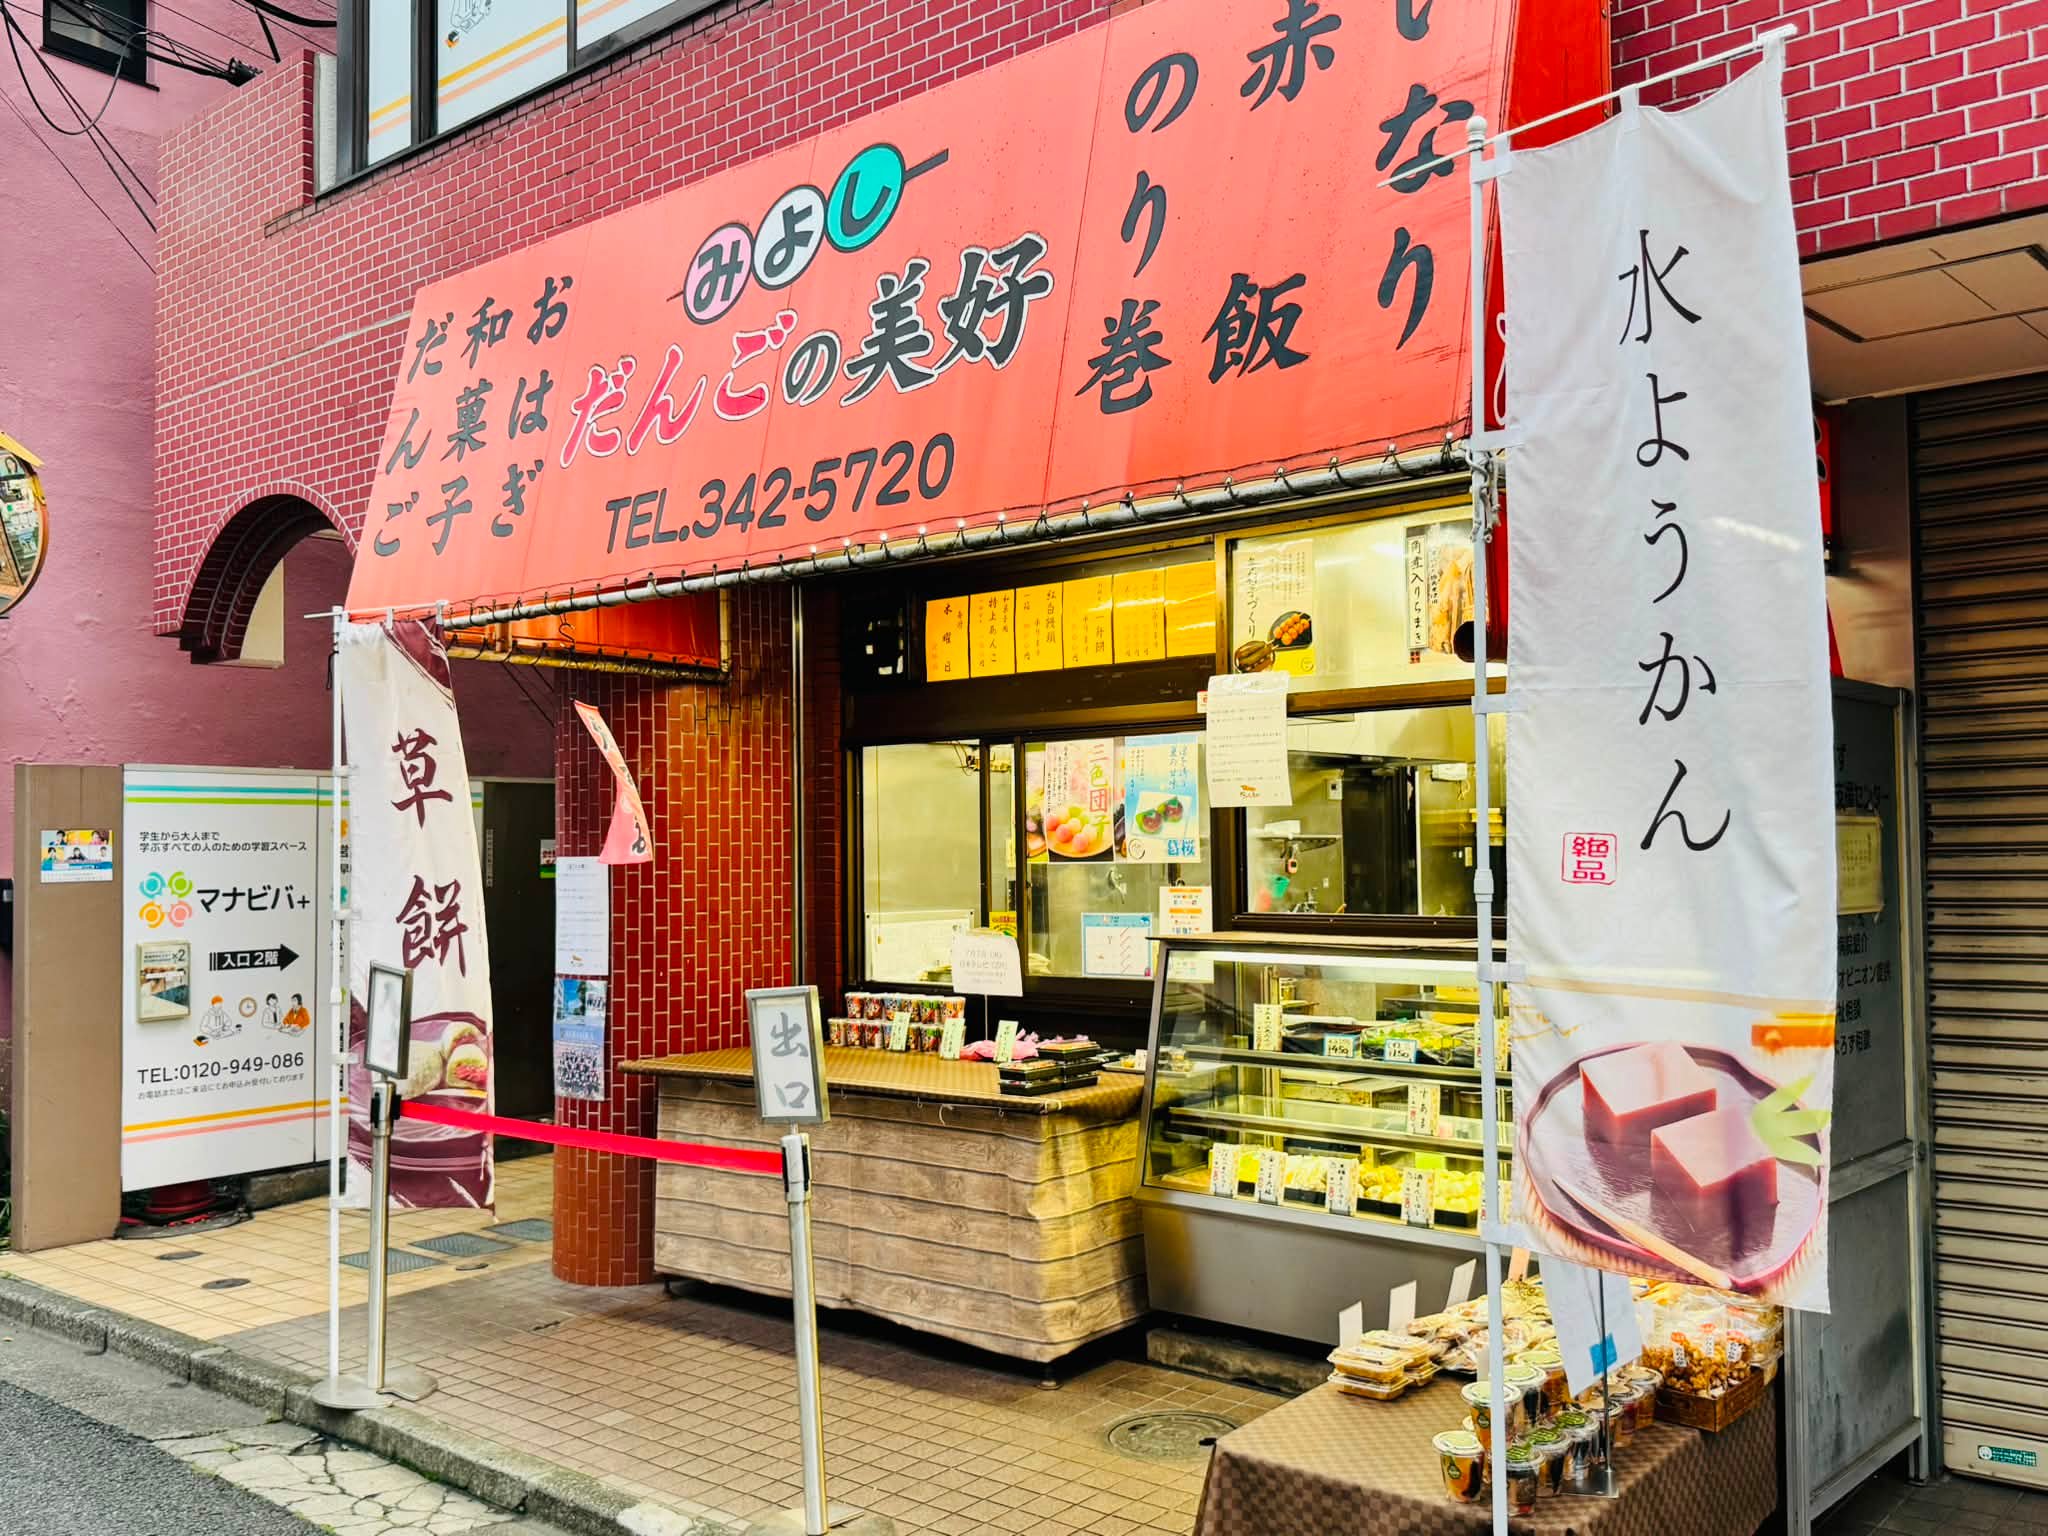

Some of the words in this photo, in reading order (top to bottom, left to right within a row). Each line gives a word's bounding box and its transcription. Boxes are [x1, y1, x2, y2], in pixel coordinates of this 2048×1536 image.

[696, 168, 892, 304] みよし
[1075, 52, 1199, 415] のり巻
[1201, 0, 1343, 385] 赤飯
[491, 275, 574, 538] おはぎ
[559, 231, 1056, 470] だんごの美好
[373, 311, 455, 557] だんご
[426, 296, 514, 557] 和菓子
[605, 432, 956, 555] TEL.342-5720
[1616, 228, 1732, 854] 水ようかん
[139, 831, 221, 842] 学生から大人まで
[139, 841, 308, 853] 学ぶすべての人のための学習スペース
[390, 726, 469, 979] 草餅
[1088, 743, 1111, 839] 三色団子
[1571, 835, 1610, 881] 絶品
[196, 884, 311, 914] マナビバ+
[137, 1051, 305, 1085] TEL:0120-949-086
[769, 1011, 810, 1110] 出口
